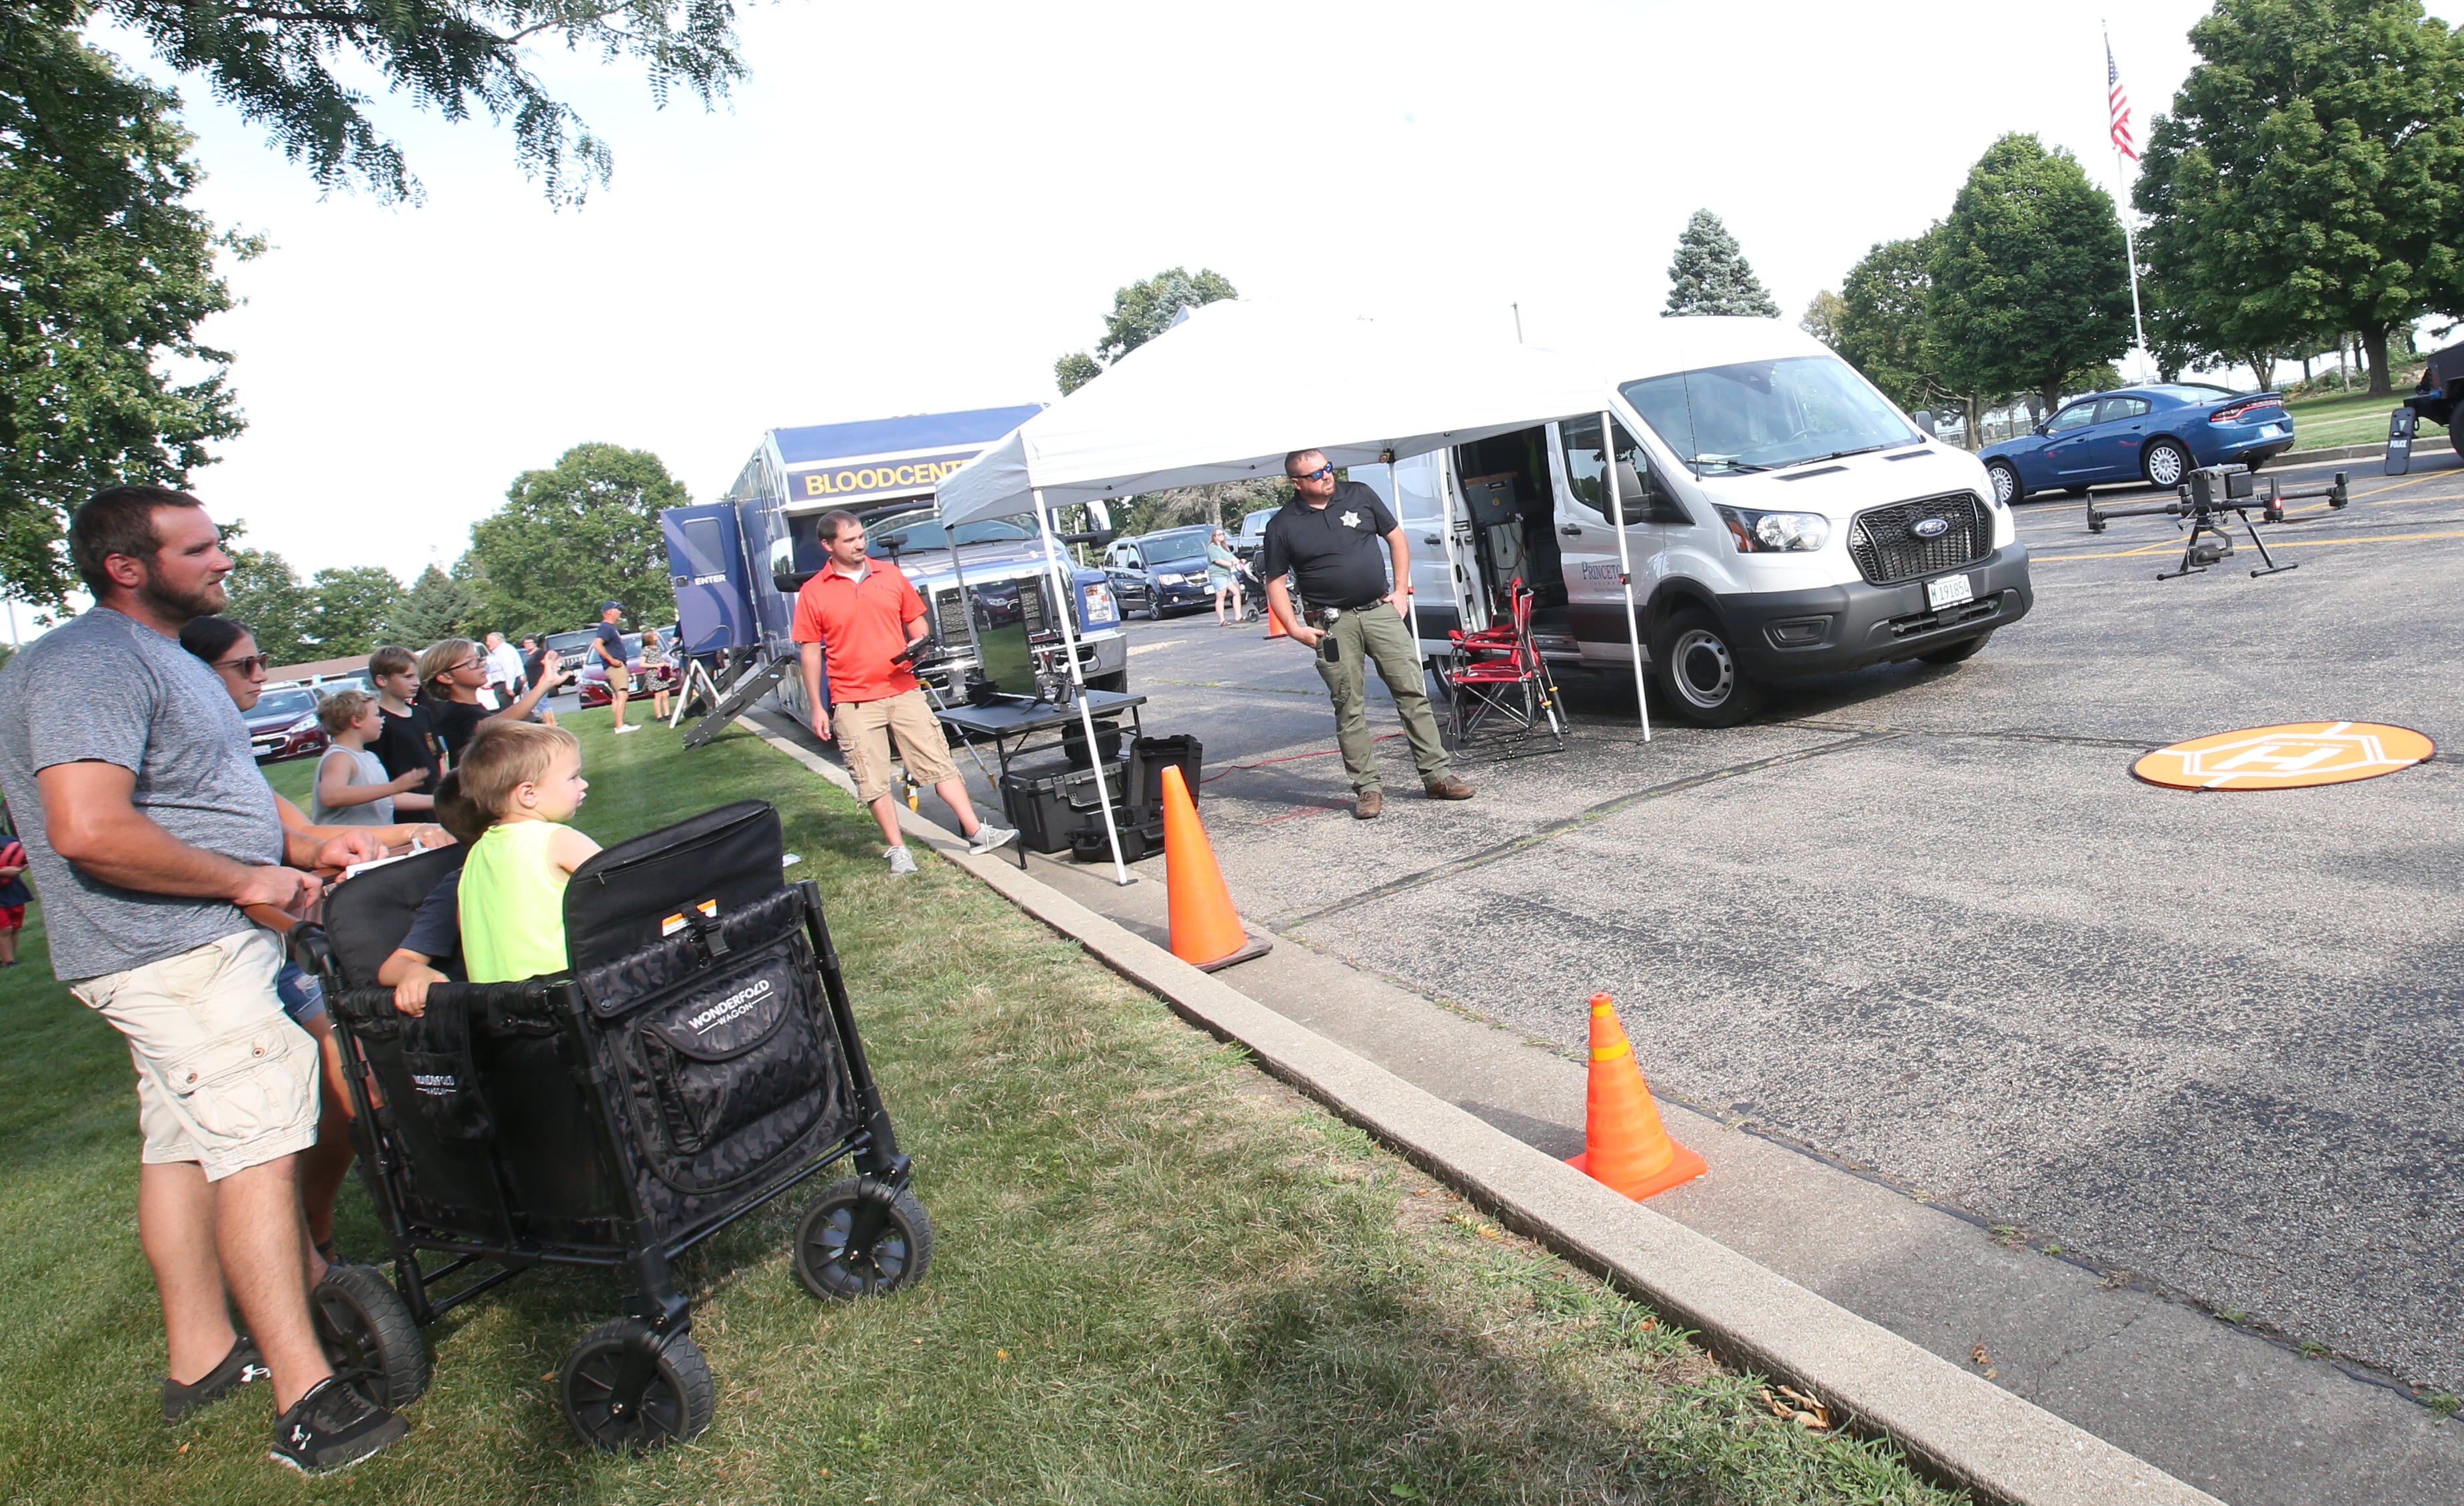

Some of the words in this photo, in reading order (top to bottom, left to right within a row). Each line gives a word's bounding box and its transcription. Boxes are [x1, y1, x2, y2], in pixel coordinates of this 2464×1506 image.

[2389, 439, 2407, 448] POLICE
[804, 458, 972, 496] BLOODCENT
[694, 574, 726, 585] ENTER
[687, 979, 770, 1029] WONDERFOLD
[716, 1002, 753, 1025] WAGON
